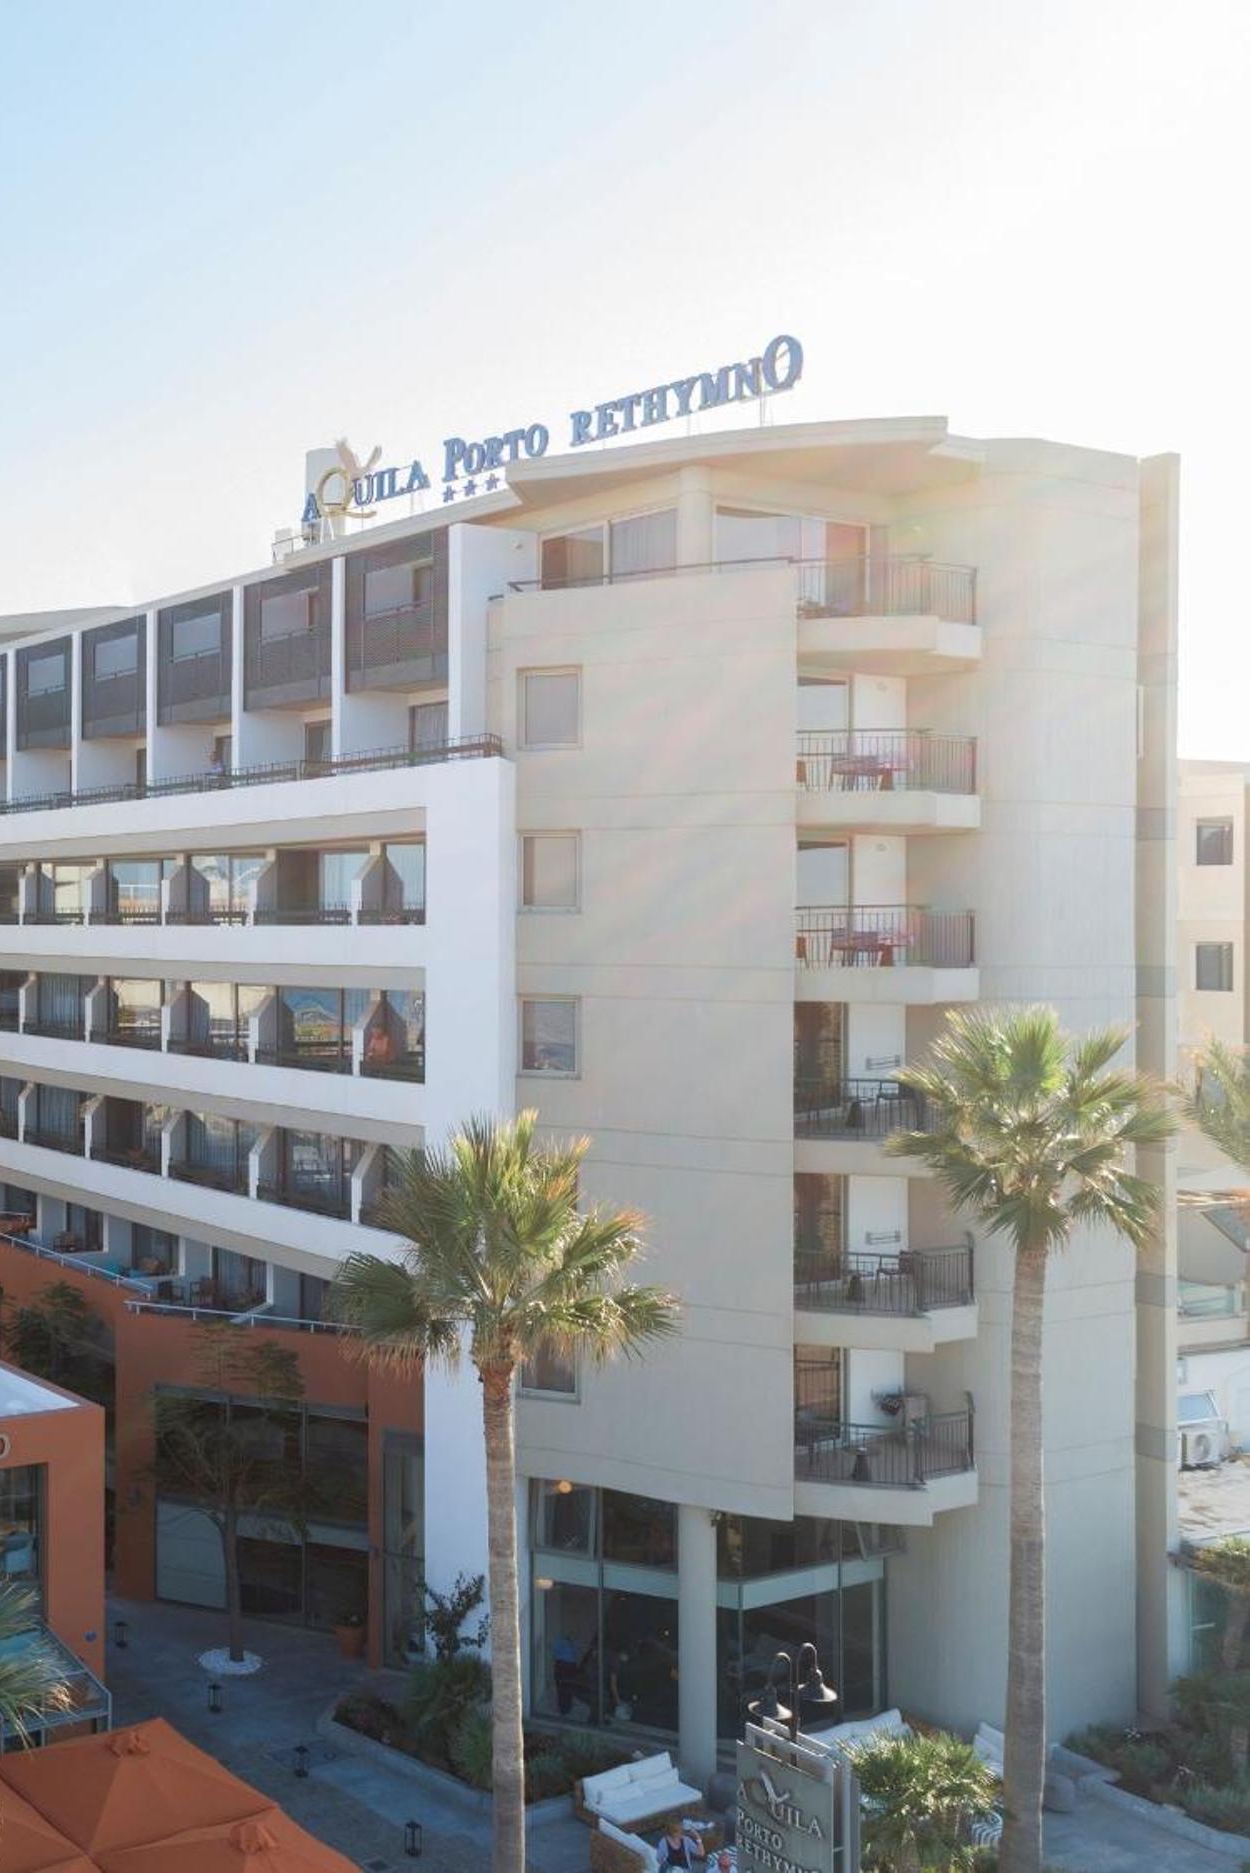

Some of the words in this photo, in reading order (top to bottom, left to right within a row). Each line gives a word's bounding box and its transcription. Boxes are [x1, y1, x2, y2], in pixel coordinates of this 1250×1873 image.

[302, 438, 431, 520] AQUILA
[443, 423, 549, 482] PORTO
[569, 334, 804, 446] RETHYMNO
[737, 1807, 782, 1850] PORTO
